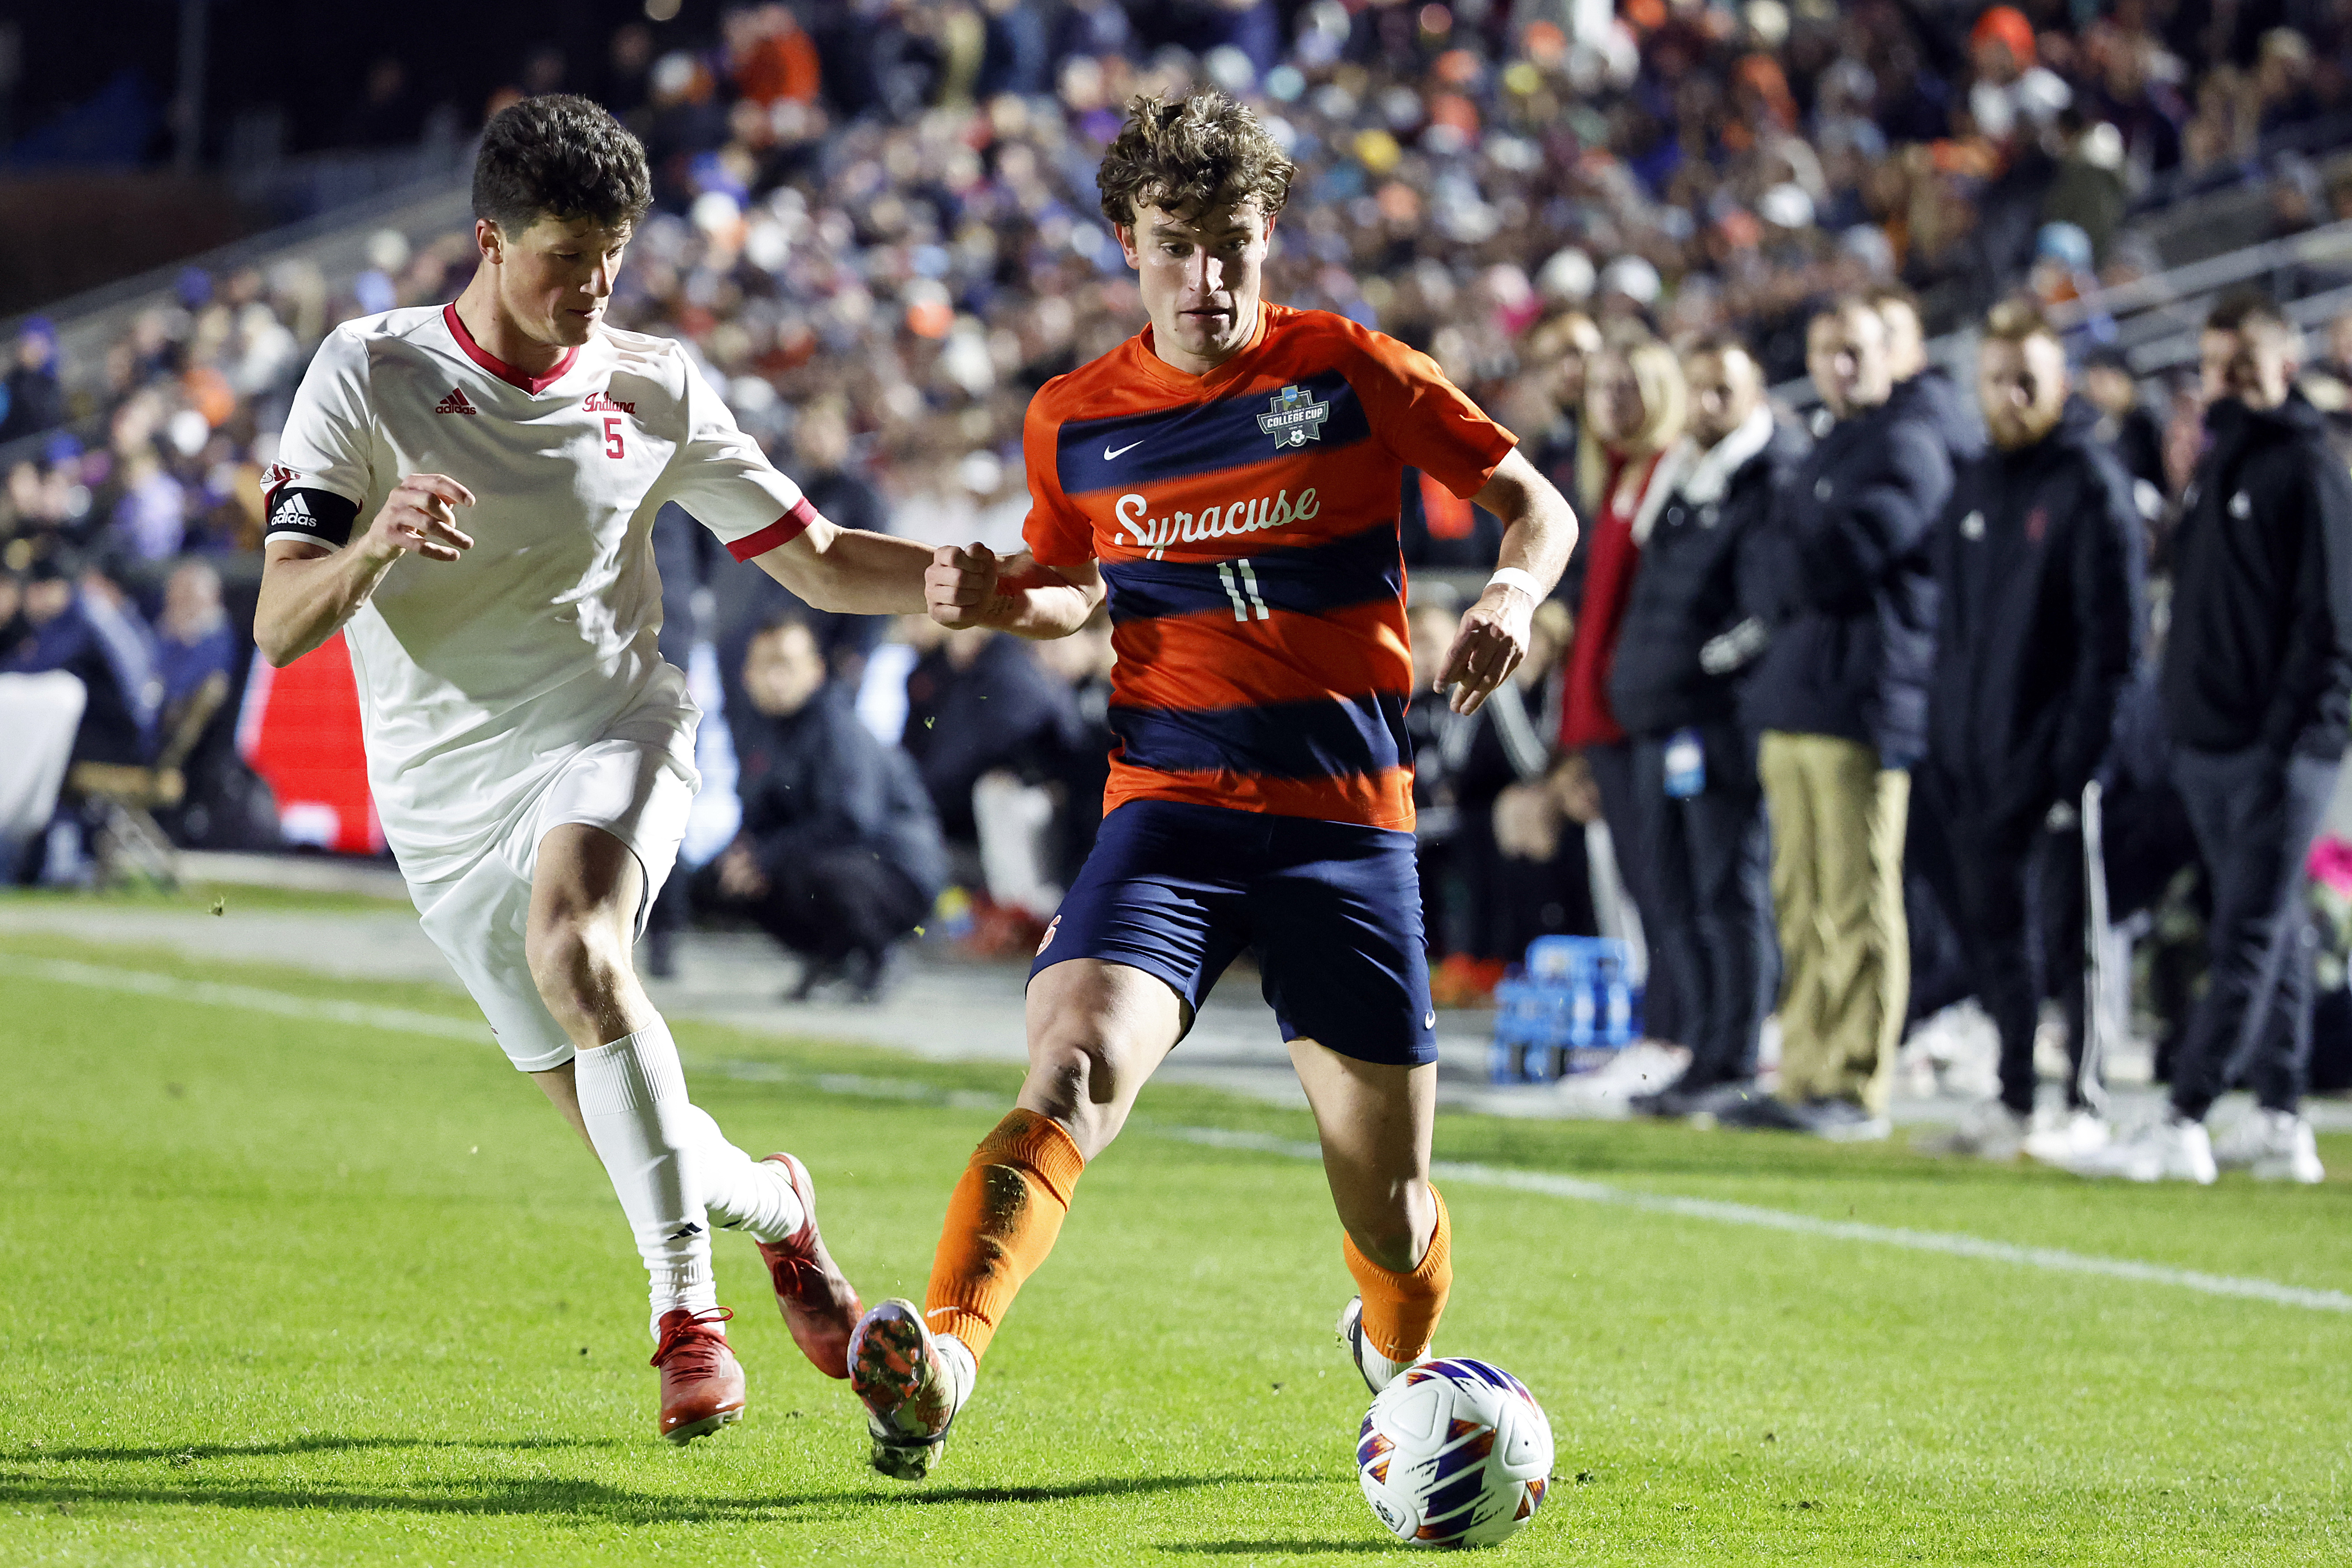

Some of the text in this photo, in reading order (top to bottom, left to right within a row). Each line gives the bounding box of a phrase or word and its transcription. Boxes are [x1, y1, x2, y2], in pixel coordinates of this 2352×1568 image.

[435, 404, 477, 415] adidas
[582, 391, 636, 414] Indiana
[1267, 408, 1323, 428] COLLEGE CUP
[604, 417, 624, 459] 5
[271, 512, 317, 527] adidas
[1114, 488, 1320, 561] Syracuse
[1216, 559, 1269, 622] 11
